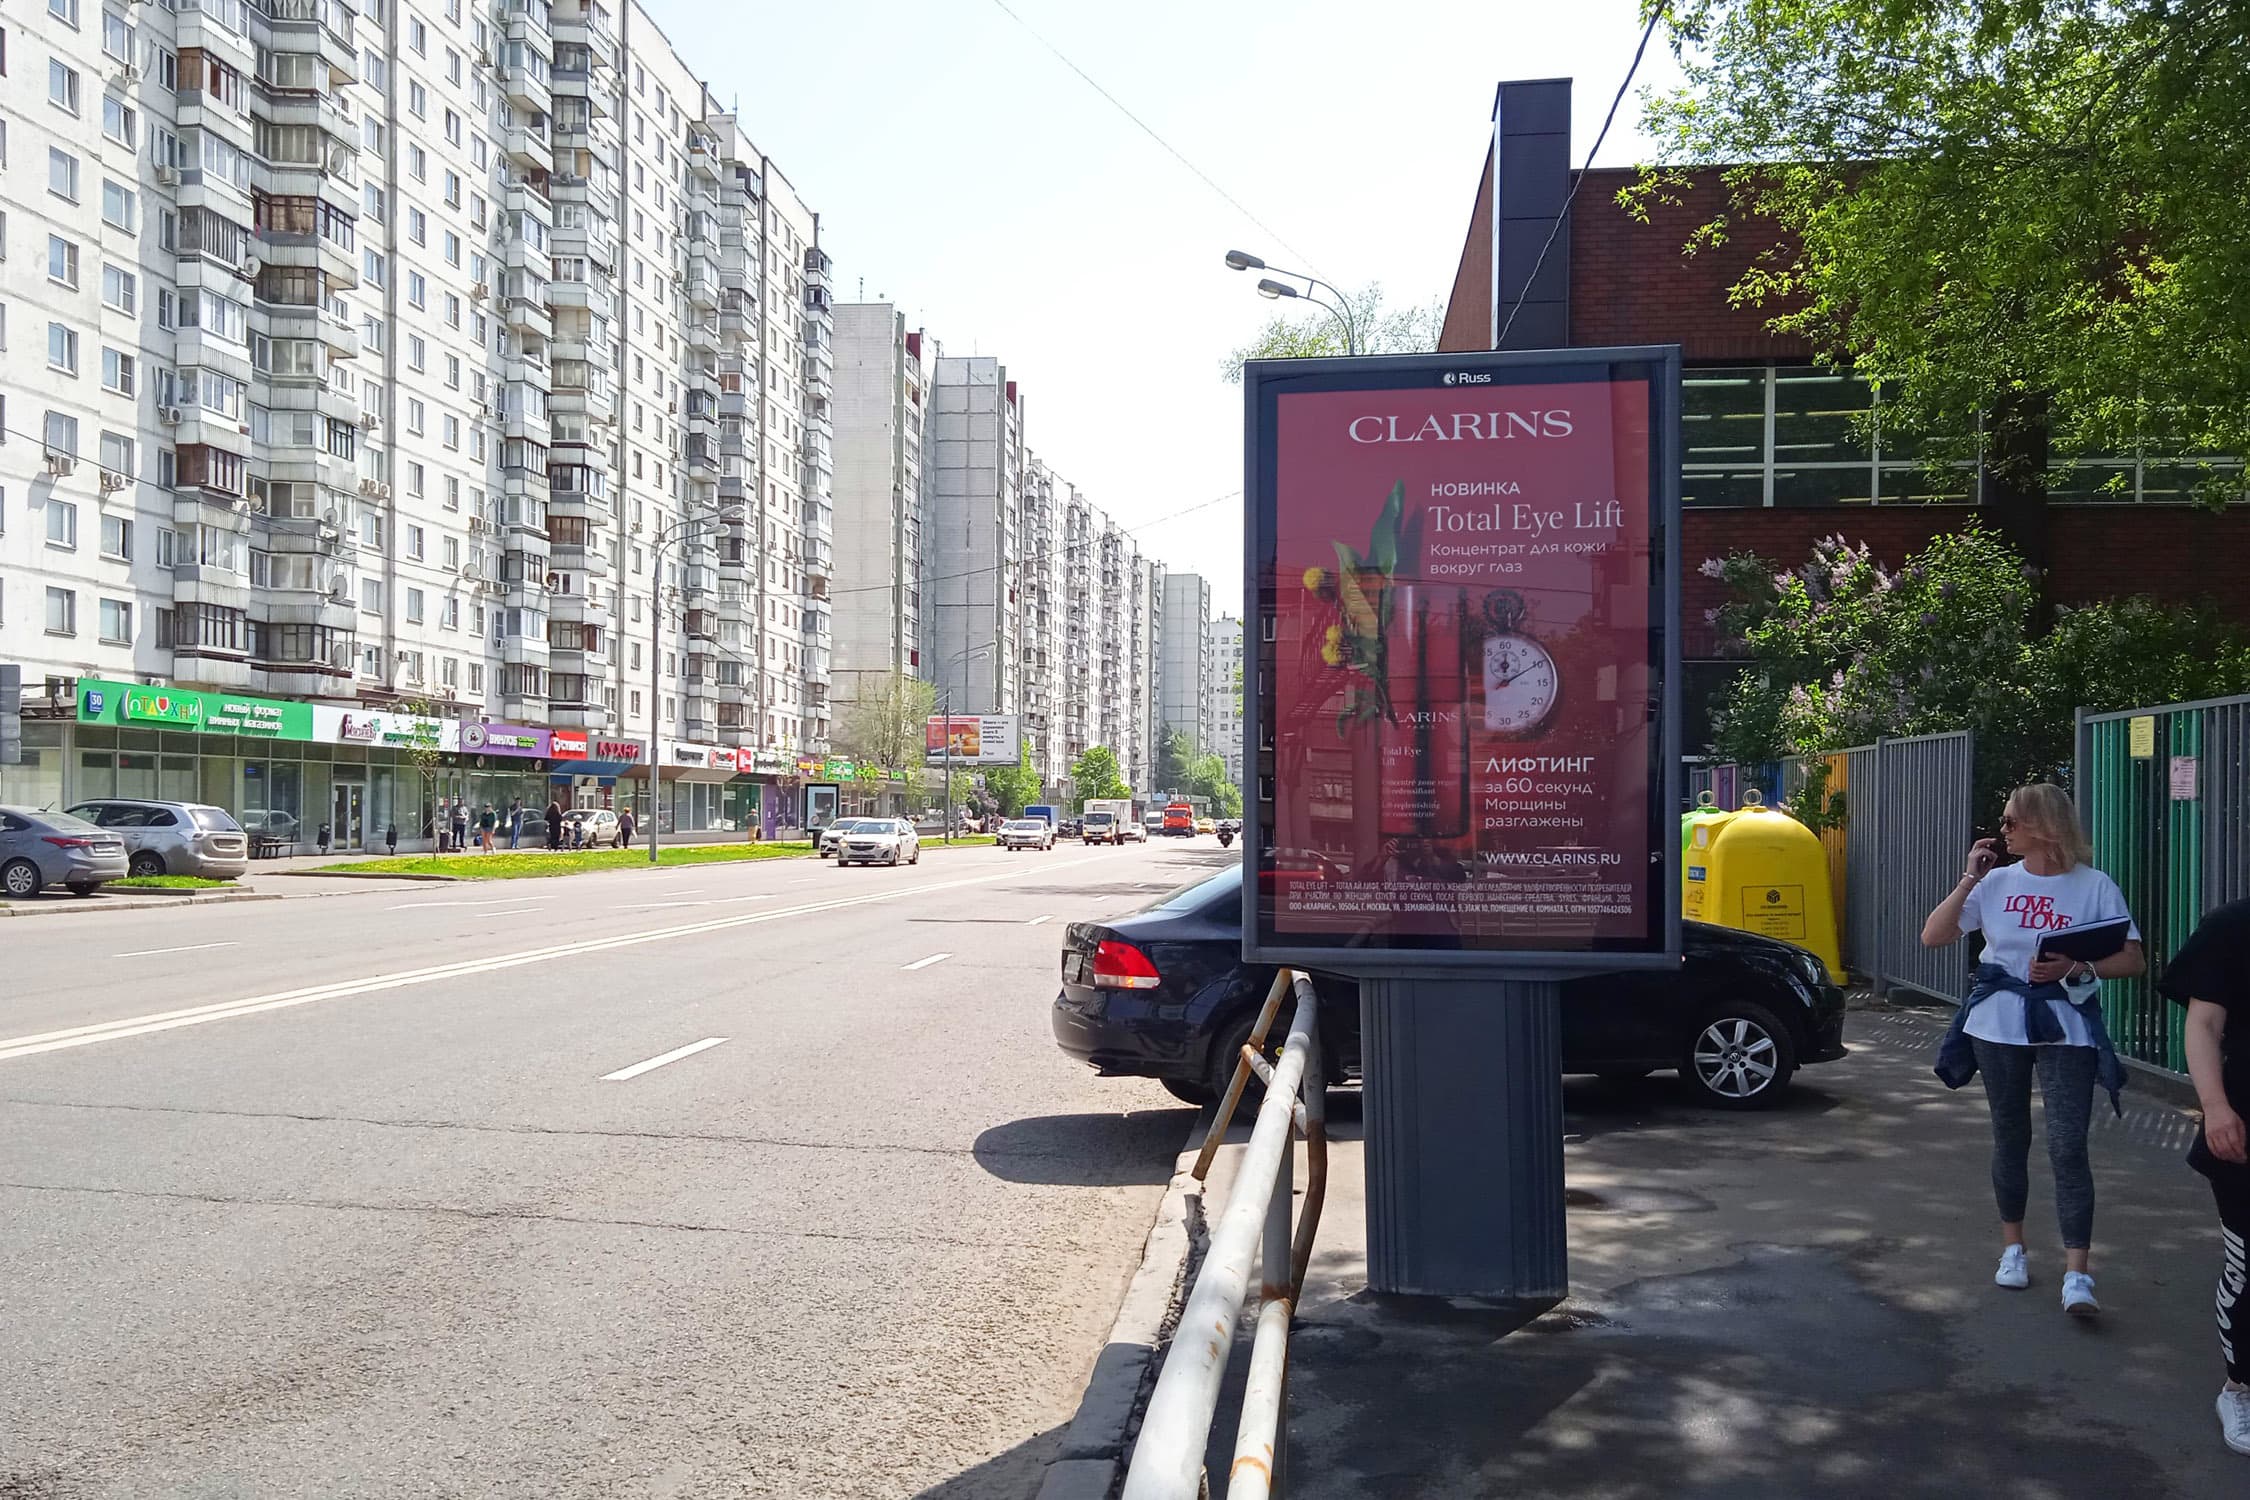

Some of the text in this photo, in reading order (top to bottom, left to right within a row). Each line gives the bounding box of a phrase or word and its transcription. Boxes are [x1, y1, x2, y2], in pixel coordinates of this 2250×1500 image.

[1459, 372, 1491, 384] Russ
[1349, 410, 1573, 443] CLARINS
[1431, 481, 1521, 497] НОВИНКА
[1428, 500, 1625, 538] Total Eye Lift
[1430, 542, 1606, 557] Концентрат для кожи
[1430, 562, 1523, 576] вокруг глаз
[1499, 642, 1511, 650] 60
[1521, 648, 1527, 656] 5
[1537, 679, 1549, 687] 15
[91, 695, 102, 706] 30
[1531, 697, 1543, 705] 20
[1499, 717, 1511, 726] 30
[1519, 711, 1530, 719] 25
[597, 742, 639, 758] КУХНИ
[1485, 757, 1595, 773] ЛИФТИНГ
[1485, 783, 1502, 793] за
[1506, 778, 1532, 793] 60
[1485, 798, 1566, 811] Морщины
[1485, 817, 1583, 829] разглажены
[1485, 853, 1621, 866] WWW.CLARINS.RU
[2003, 895, 2055, 913] LOVE
[2018, 911, 2072, 930] LOVE
